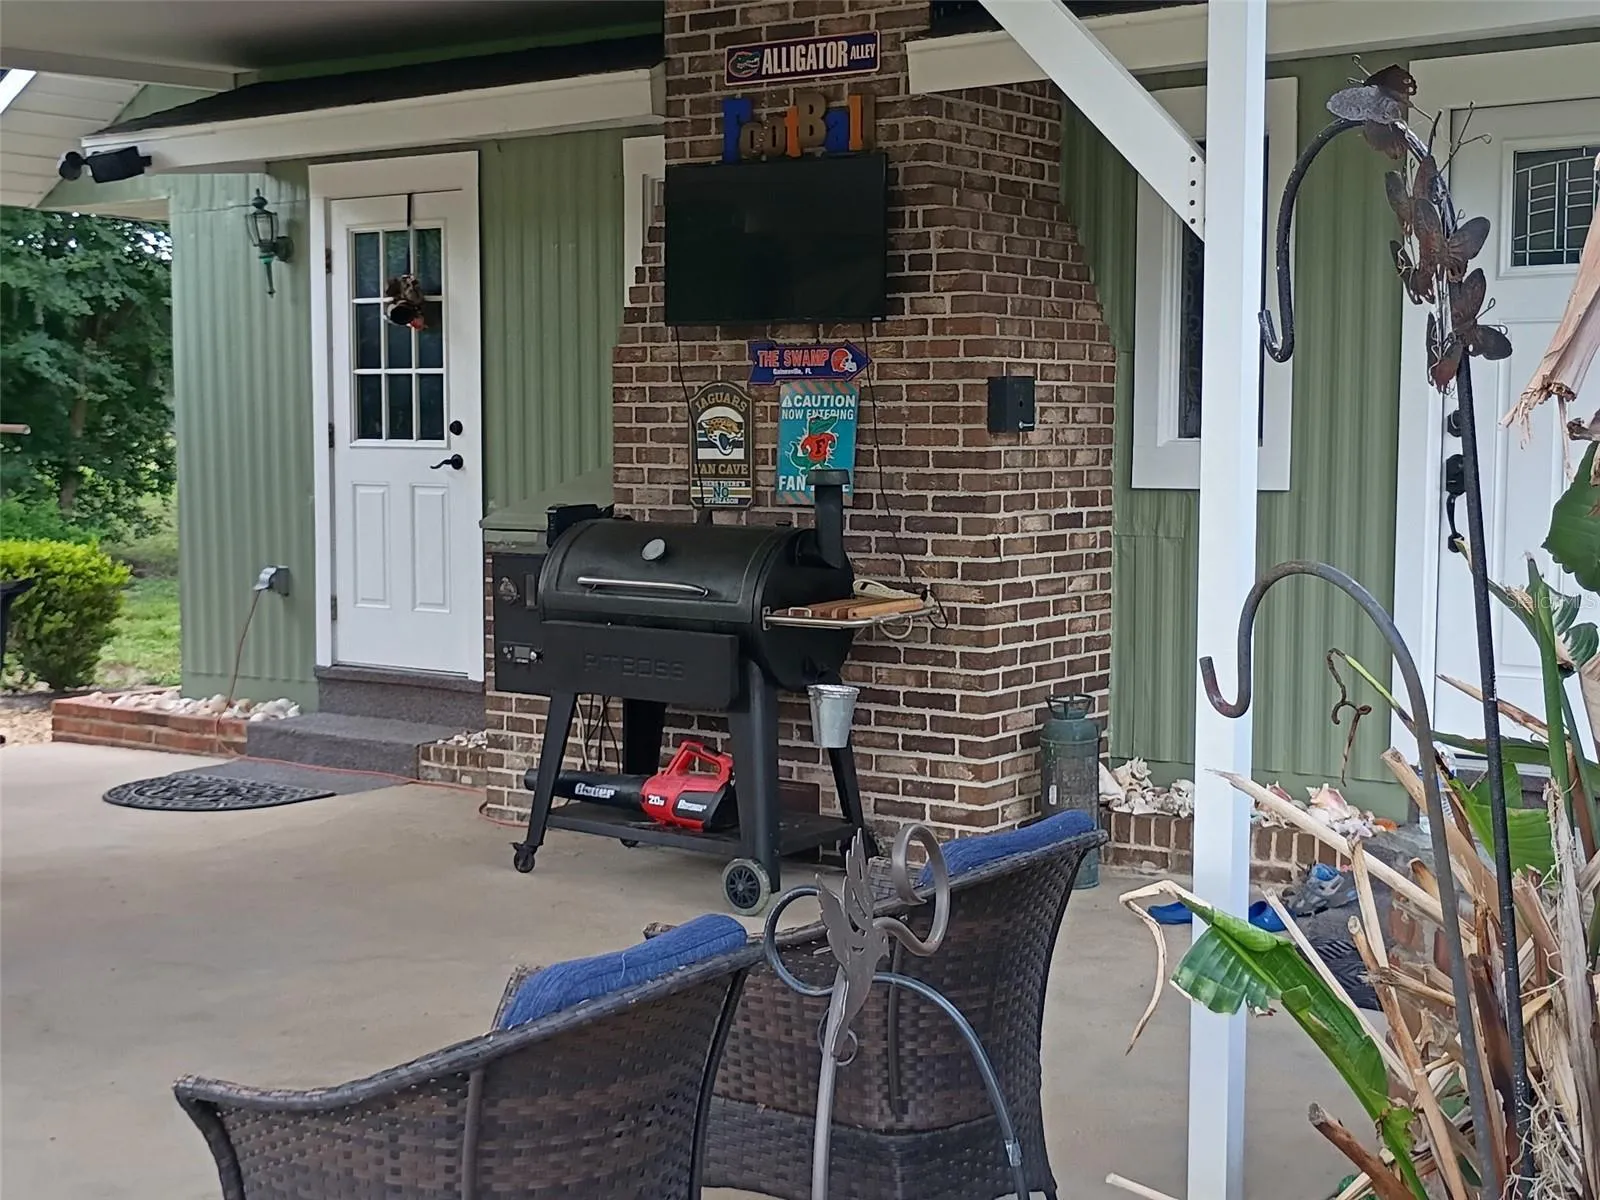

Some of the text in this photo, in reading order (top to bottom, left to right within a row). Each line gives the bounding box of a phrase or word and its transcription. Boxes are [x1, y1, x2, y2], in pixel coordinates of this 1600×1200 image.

[761, 41, 876, 75] ALLIGATOR ALLEY
[757, 348, 829, 368] THE SWAMP
[695, 391, 748, 412] JAGUARS
[793, 394, 856, 408] CAUTION
[781, 409, 804, 420] NOW
[718, 463, 749, 475] CAVE
[778, 475, 806, 492] FAN
[713, 487, 730, 498] NO
